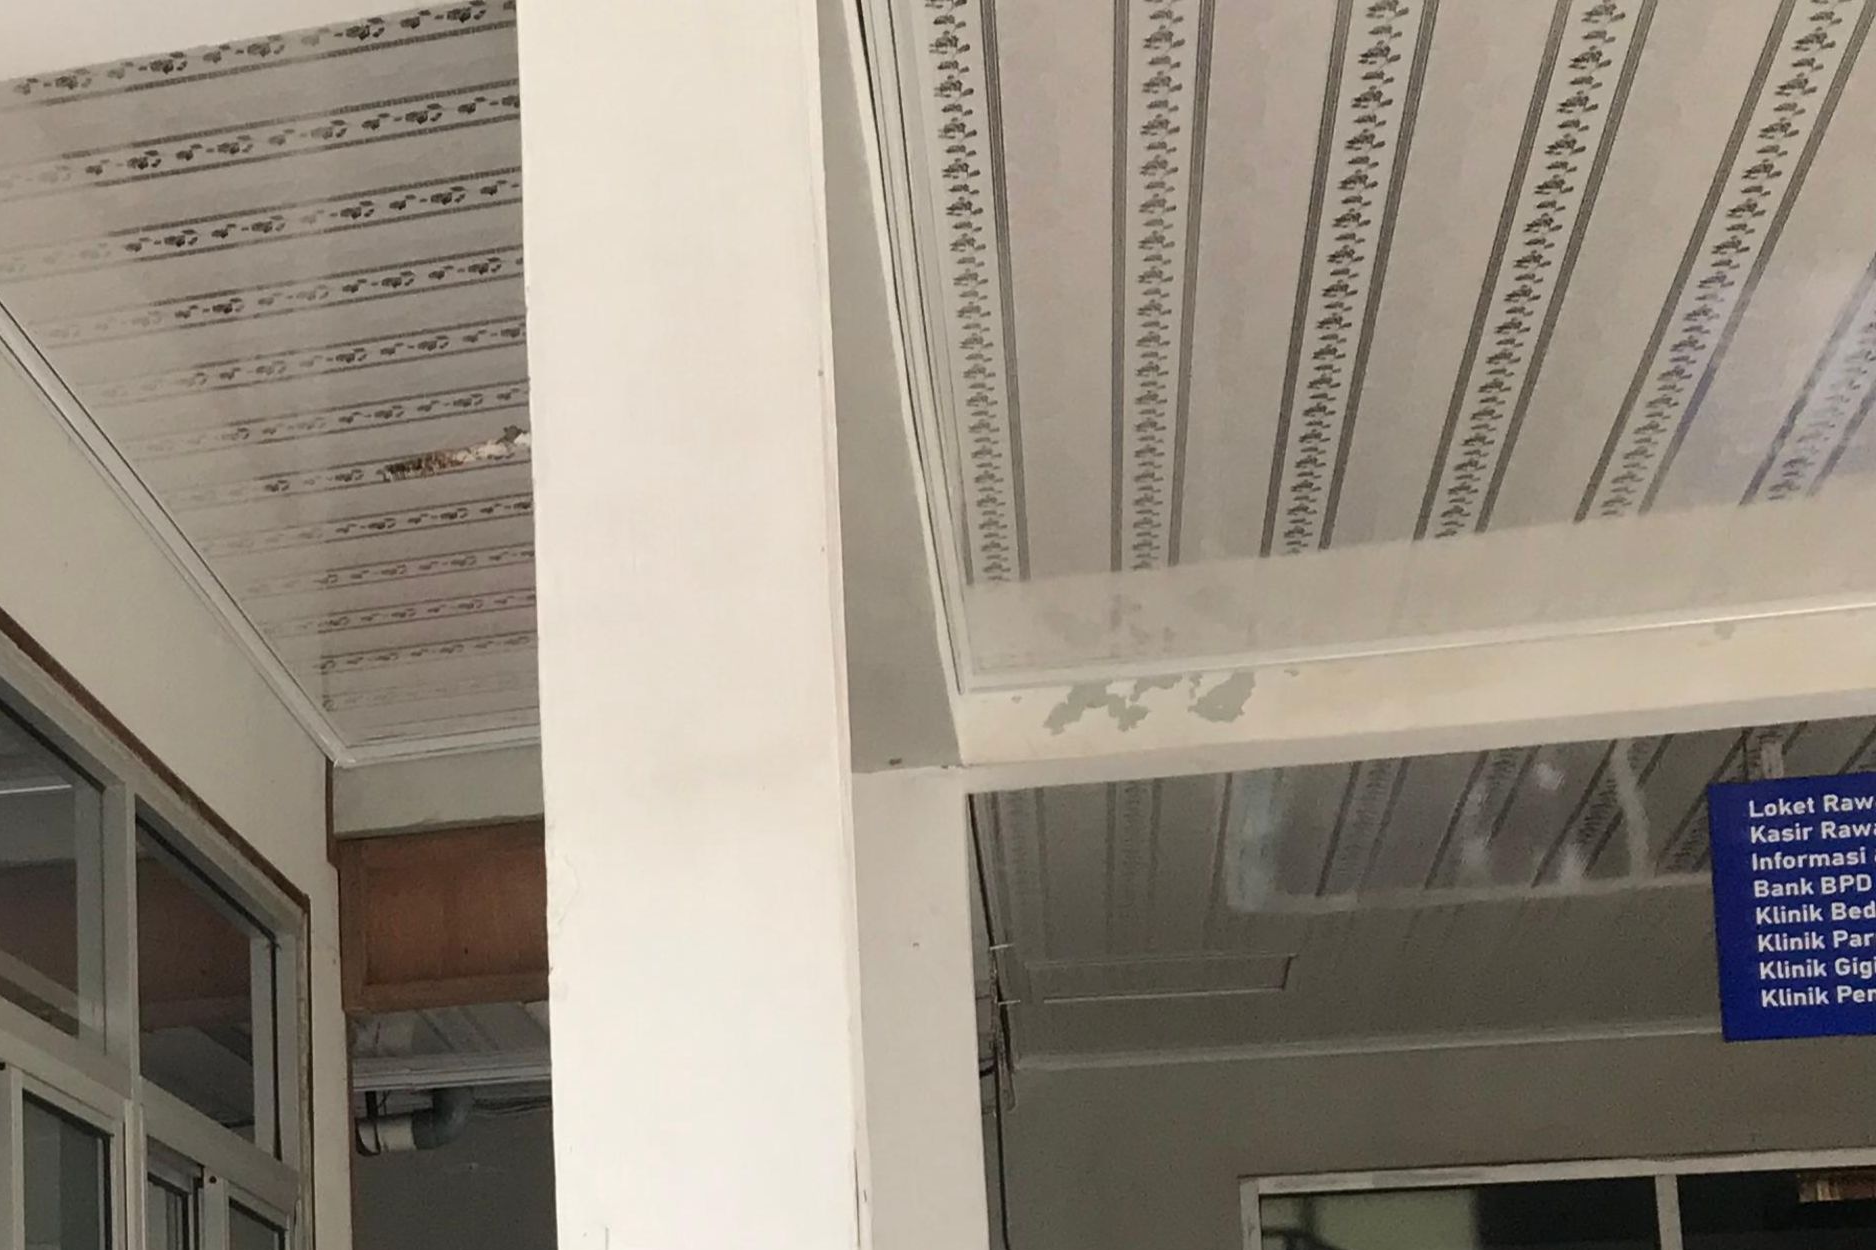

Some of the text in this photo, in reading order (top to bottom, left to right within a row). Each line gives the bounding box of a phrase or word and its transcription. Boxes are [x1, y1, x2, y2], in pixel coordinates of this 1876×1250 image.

[1748, 794, 1876, 818] Loket Raw
[1750, 821, 1876, 844] Kasir Raw
[1751, 847, 1866, 871] Informasi
[1753, 873, 1872, 898] Bank BPD
[1755, 904, 1823, 925] Klinik
[1757, 931, 1825, 952] Klinik
[1759, 958, 1827, 980] Klinik
[1761, 986, 1829, 1007] Klinik
